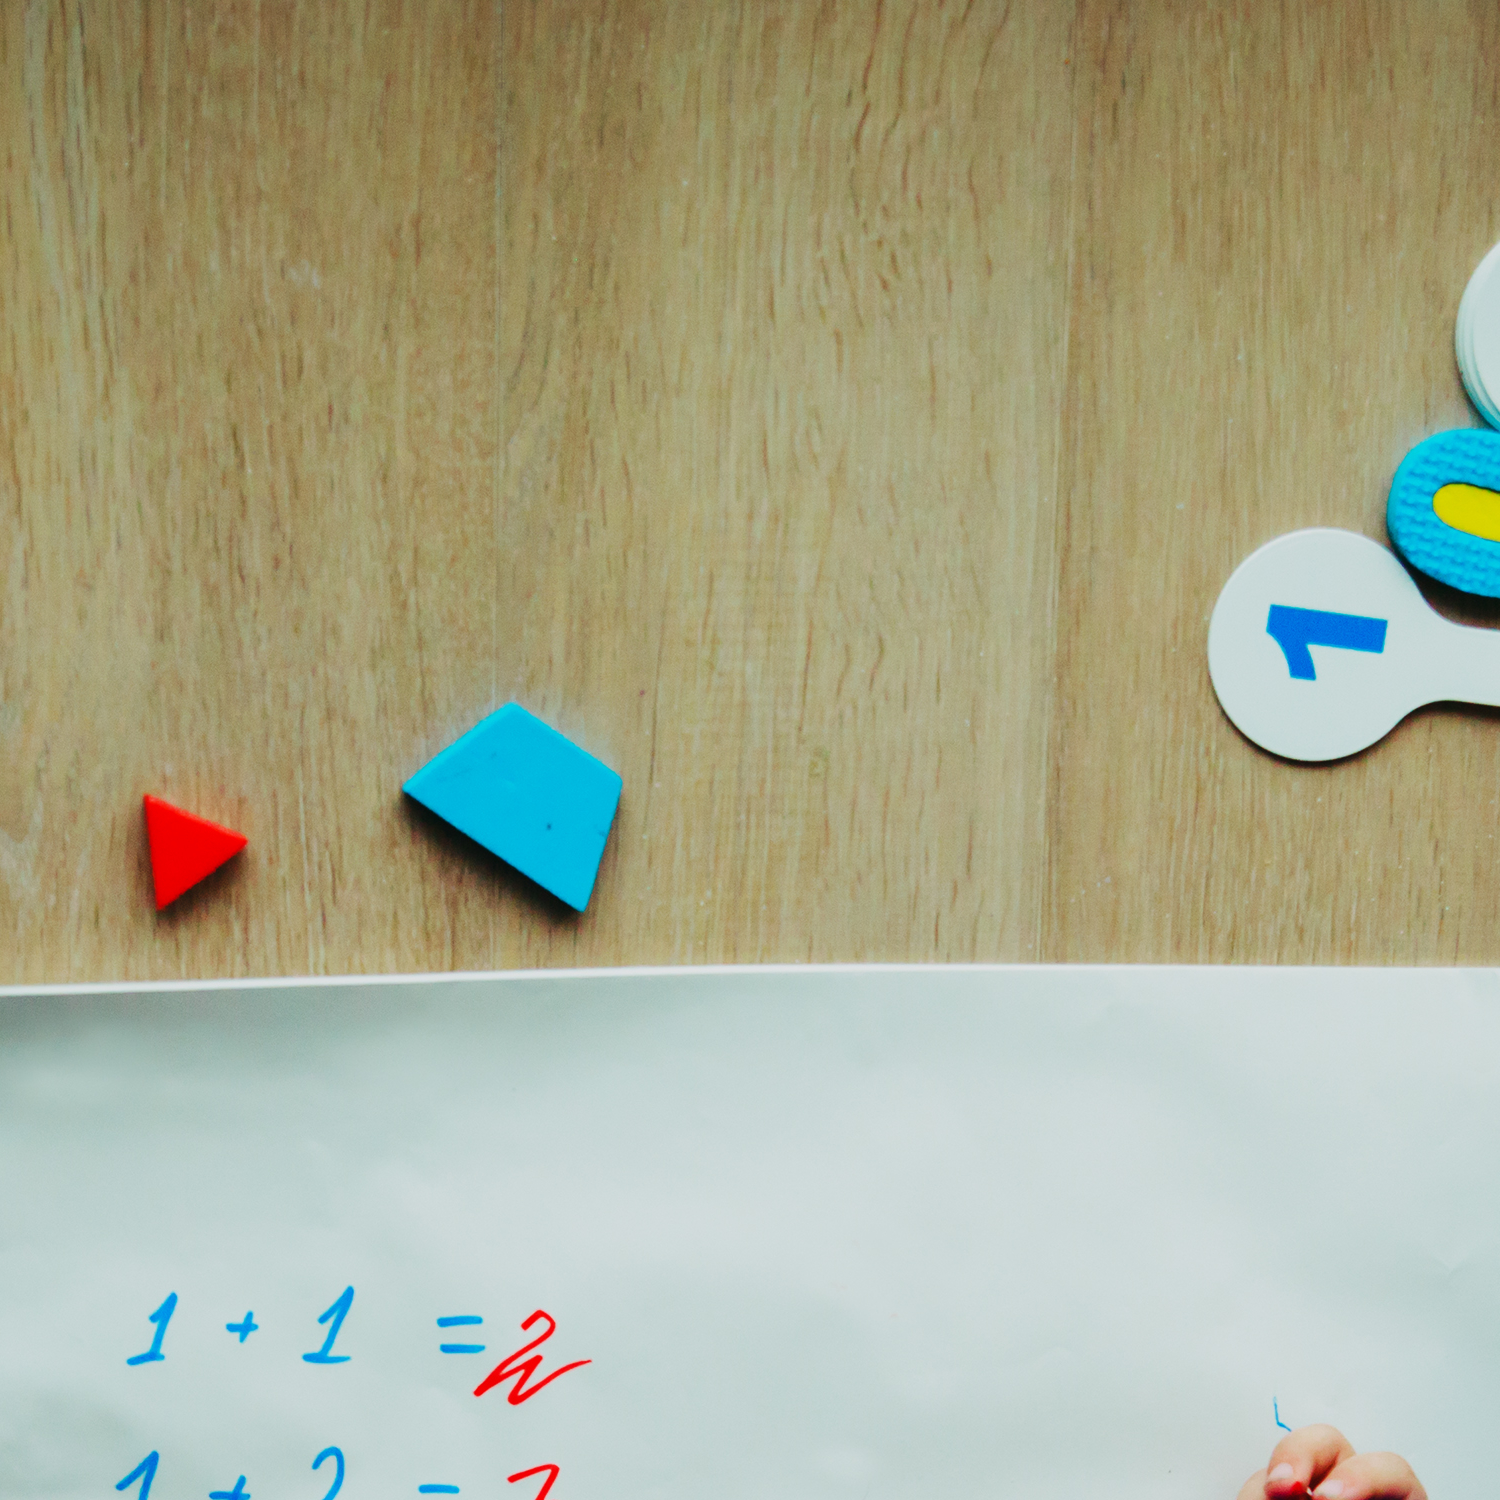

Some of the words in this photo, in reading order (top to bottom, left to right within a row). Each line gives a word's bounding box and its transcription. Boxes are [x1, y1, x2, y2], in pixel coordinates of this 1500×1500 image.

[126, 1291, 178, 1366] 1
[226, 1310, 259, 1343] +
[302, 1285, 355, 1364] 1
